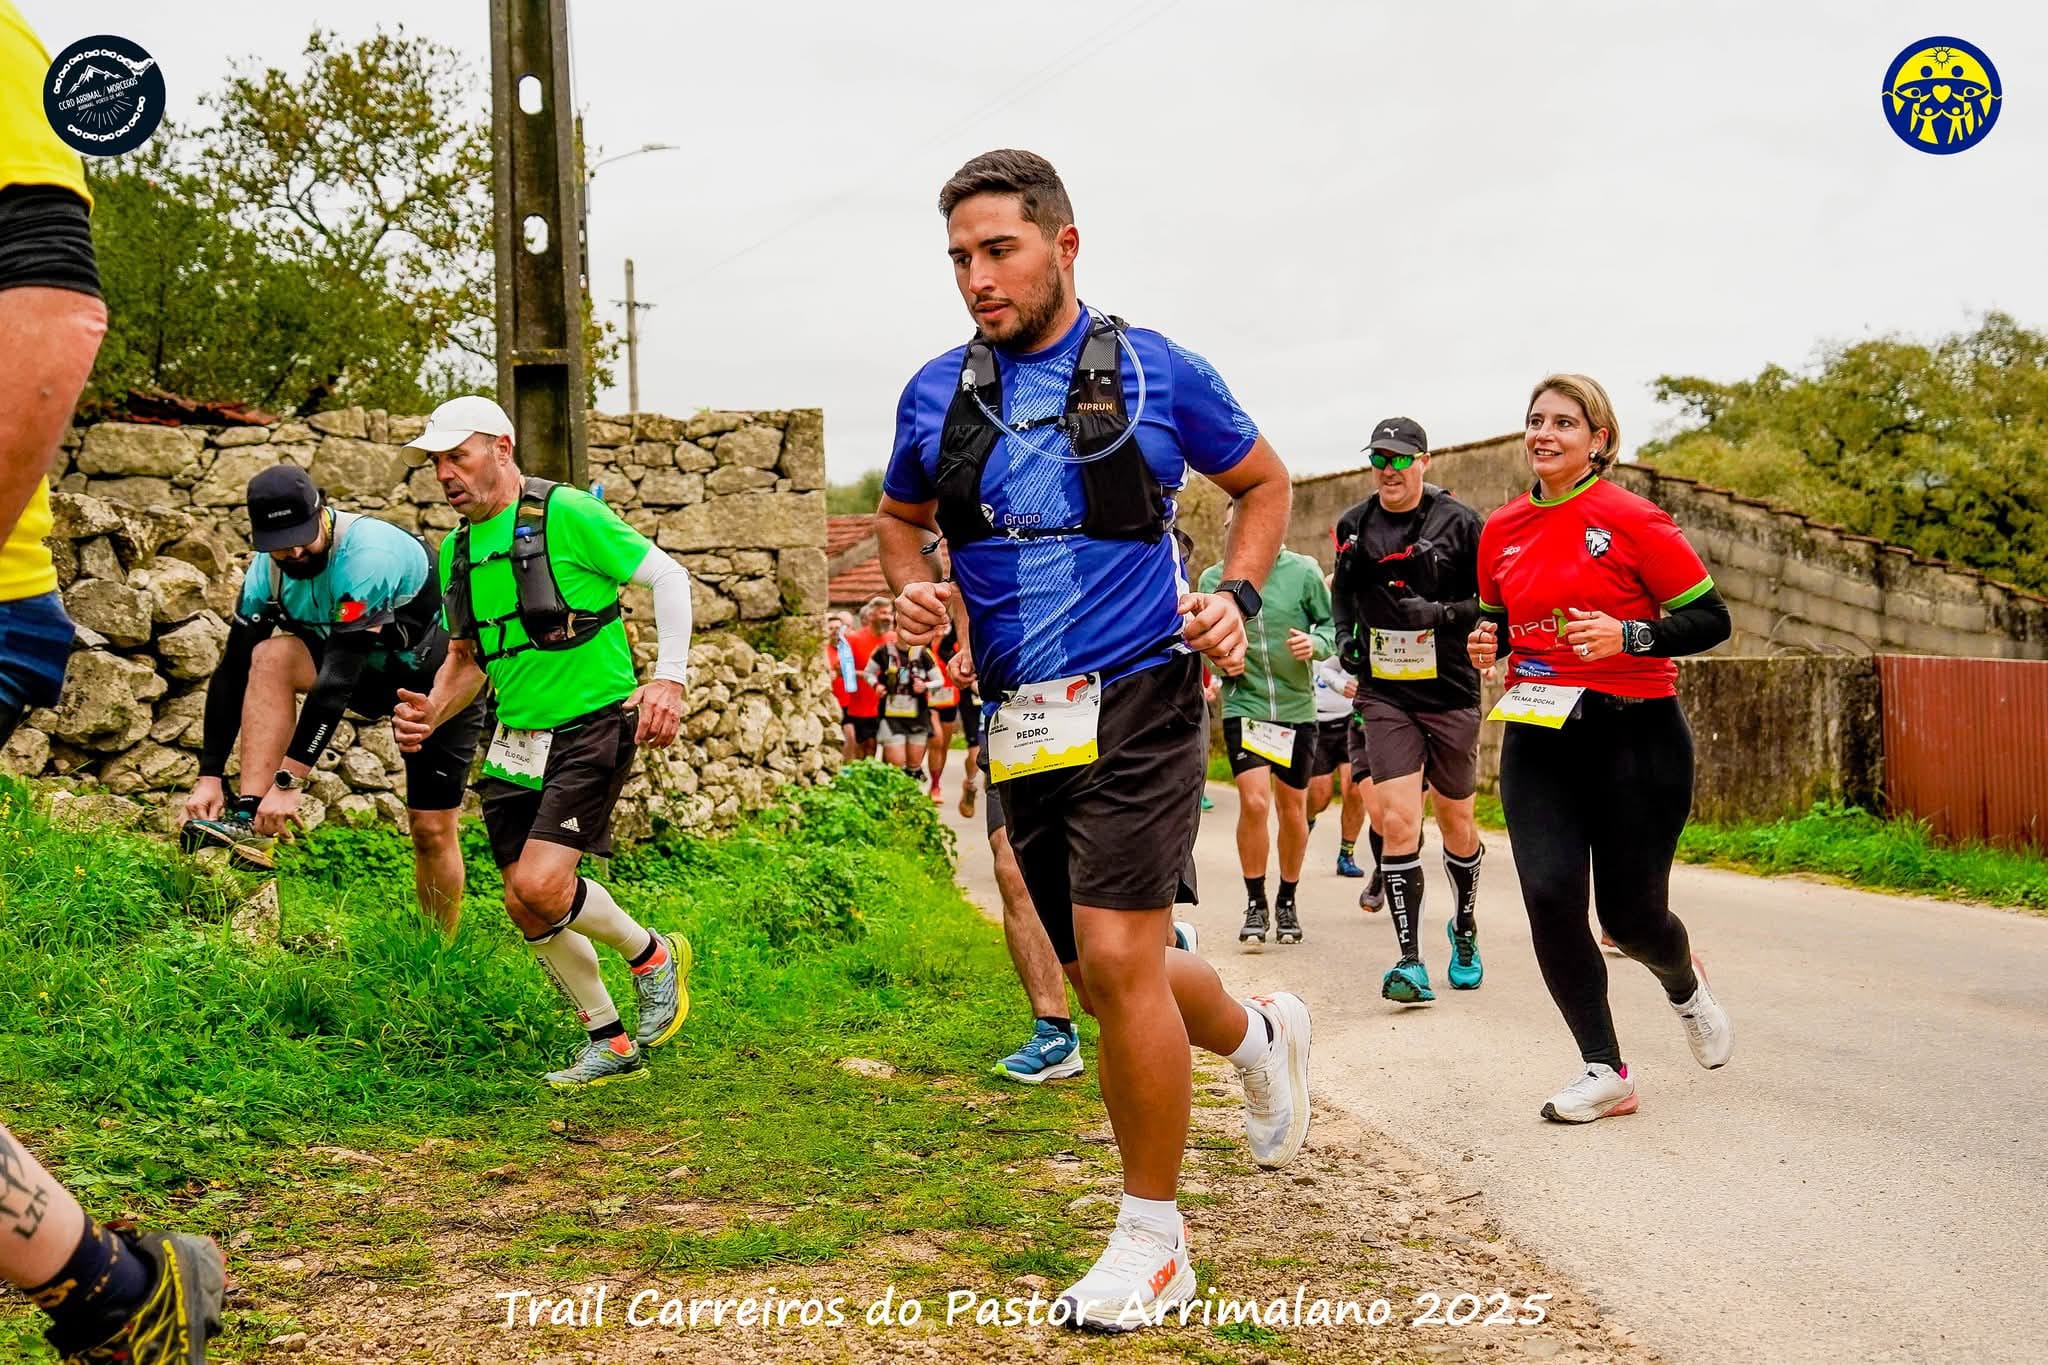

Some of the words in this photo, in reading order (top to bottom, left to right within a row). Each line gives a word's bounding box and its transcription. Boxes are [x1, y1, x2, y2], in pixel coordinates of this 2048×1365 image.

[1076, 402, 1113, 411] KIPRUN
[1003, 513, 1041, 527] Grupo
[1531, 685, 1547, 693] 623
[1511, 695, 1532, 703] TELMA
[1532, 698, 1556, 706] ROCHA
[1022, 712, 1046, 721] 734
[307, 723, 328, 754] KIPRUN
[1016, 727, 1049, 740] PEDRO
[1148, 1257, 1177, 1298] HOKA
